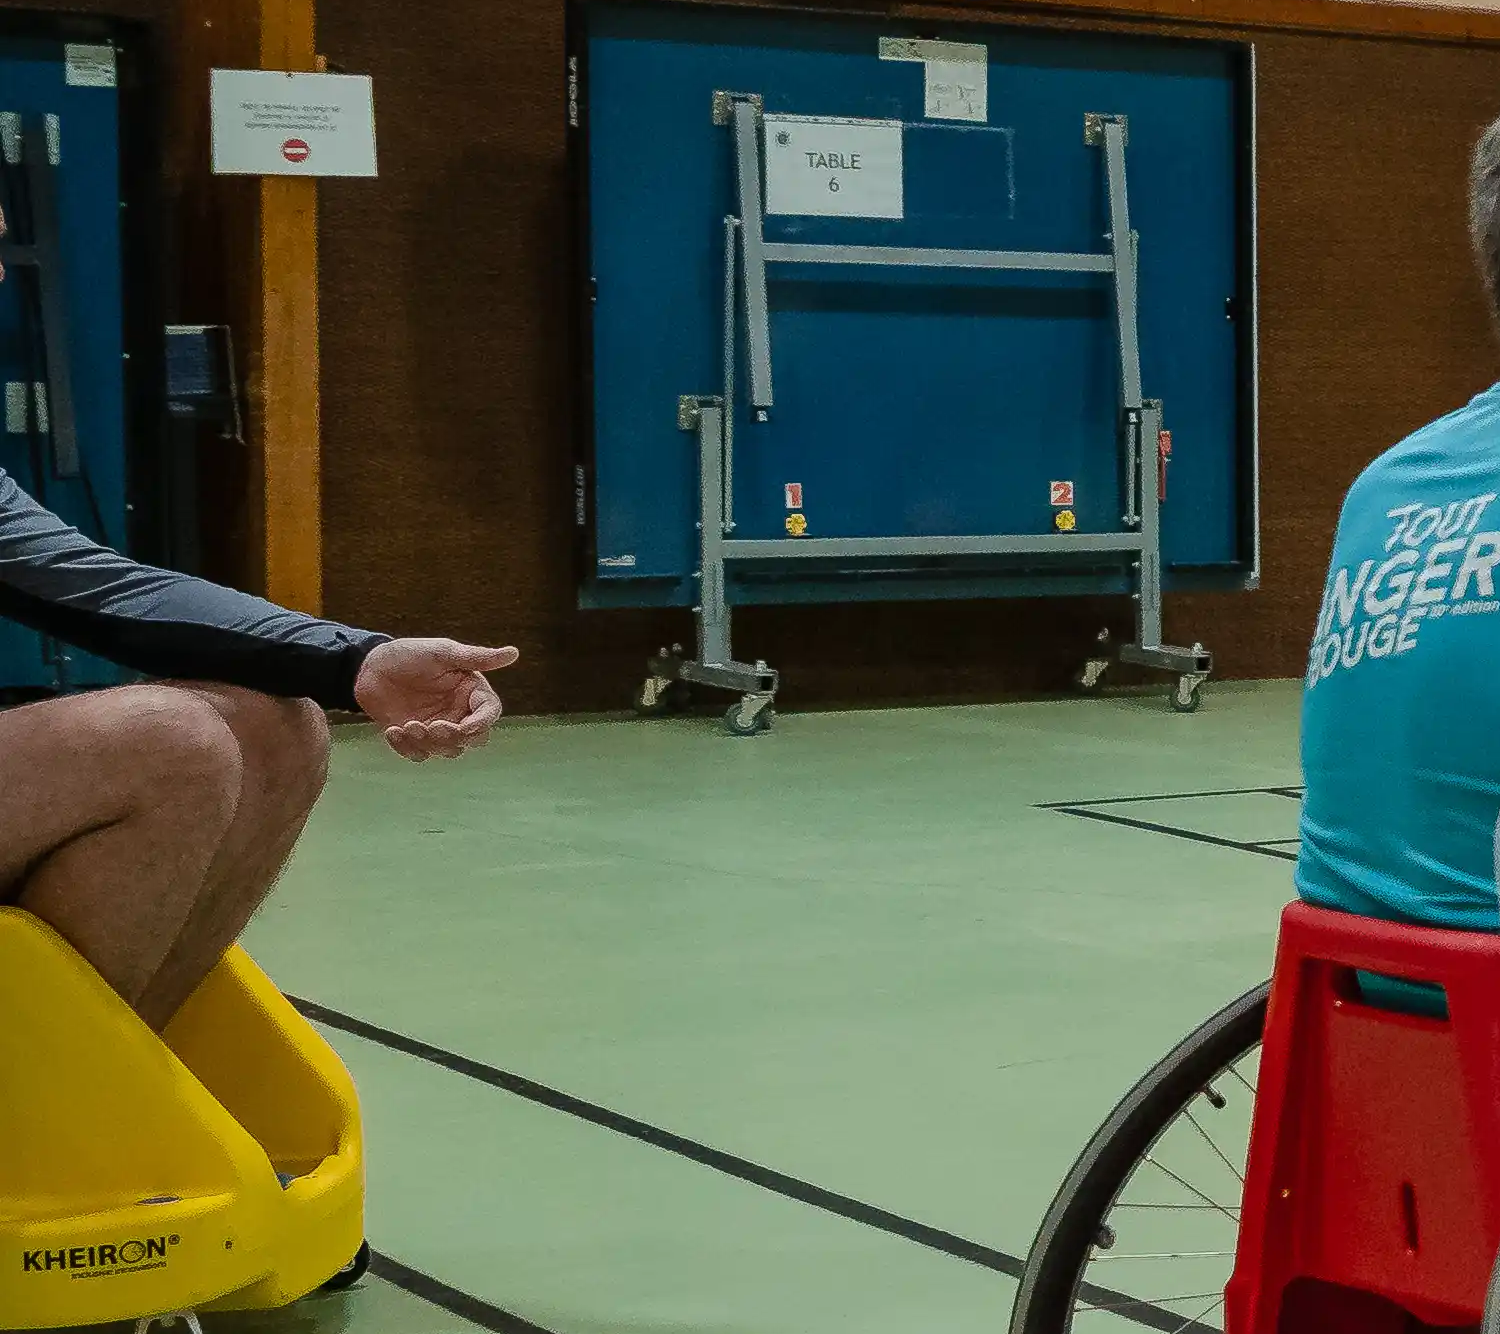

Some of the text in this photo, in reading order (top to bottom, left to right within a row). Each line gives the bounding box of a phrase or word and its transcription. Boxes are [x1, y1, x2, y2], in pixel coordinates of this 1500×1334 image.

[805, 152, 862, 170] TABLE
[829, 176, 839, 193] 6
[1052, 482, 1073, 504] 2
[1385, 491, 1498, 552] TOUT
